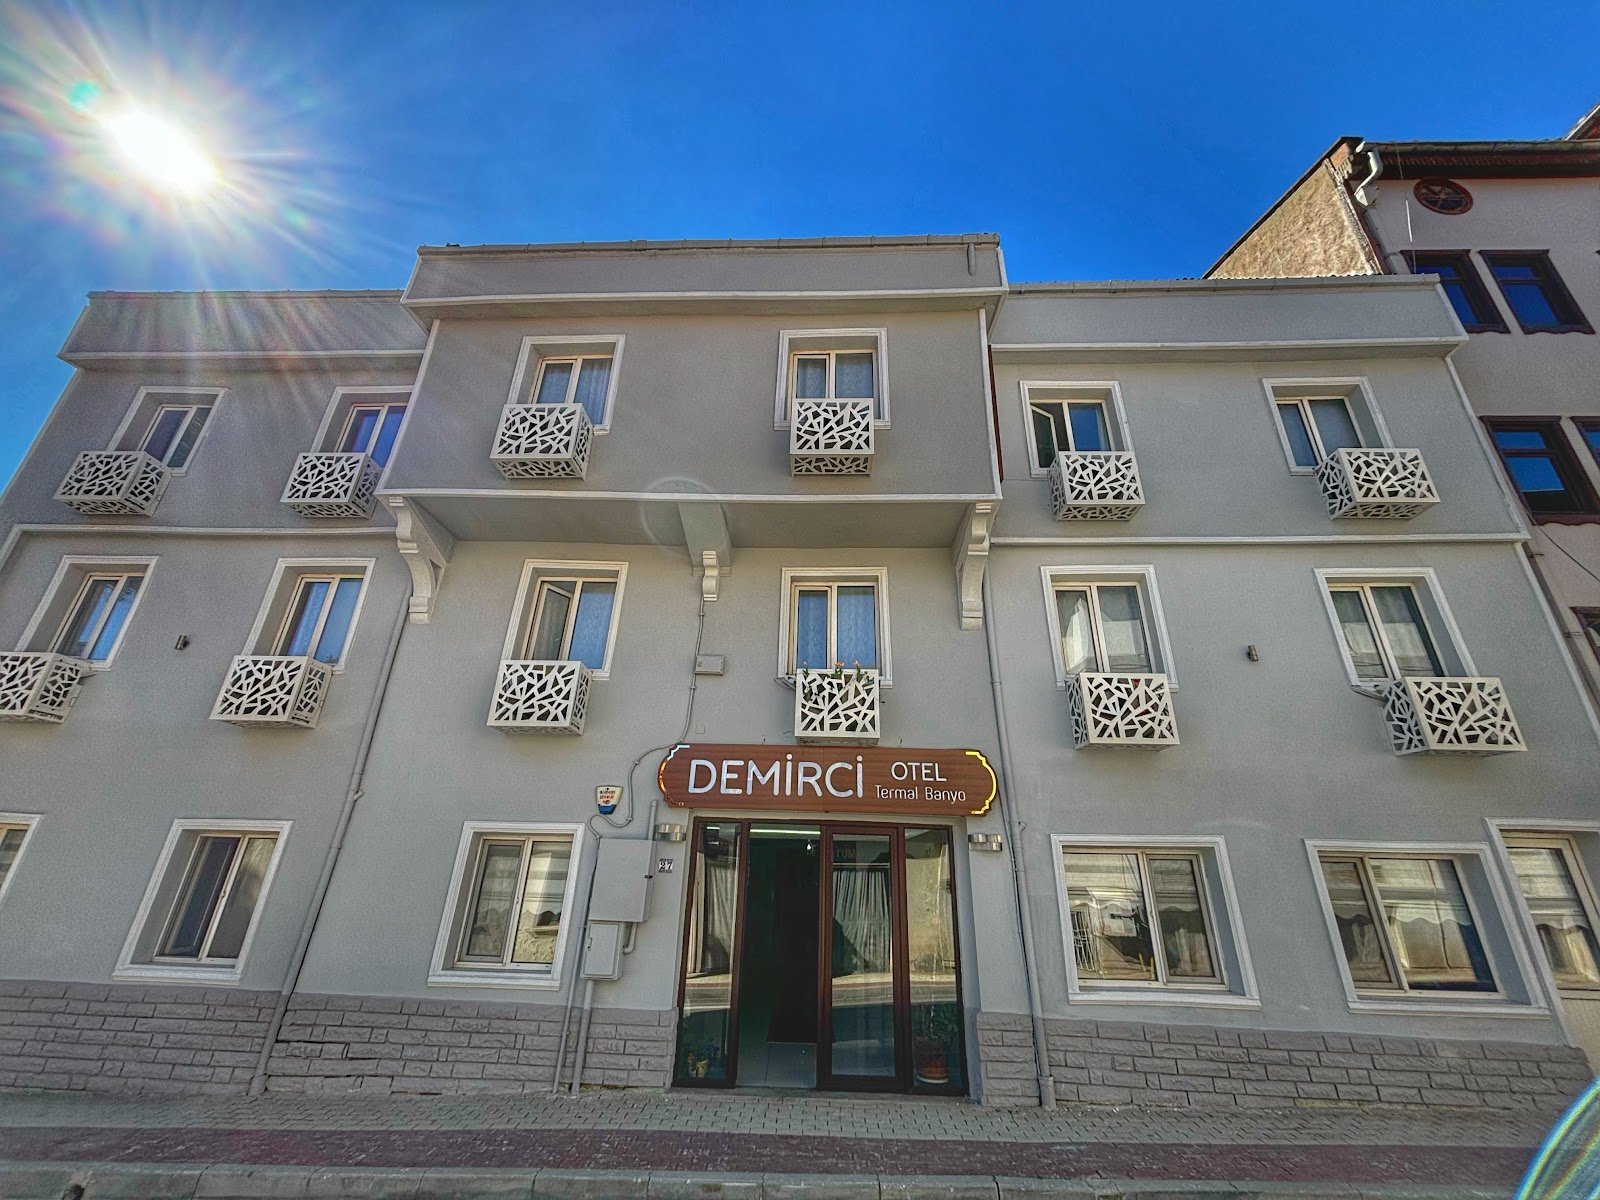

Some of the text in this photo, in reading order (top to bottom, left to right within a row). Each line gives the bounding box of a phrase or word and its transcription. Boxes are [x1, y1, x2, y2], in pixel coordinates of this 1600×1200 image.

[688, 753, 863, 798] DEMİRCİ
[891, 761, 947, 782] OTEL
[875, 784, 966, 805] Termal Banyo
[659, 860, 673, 871] 27
